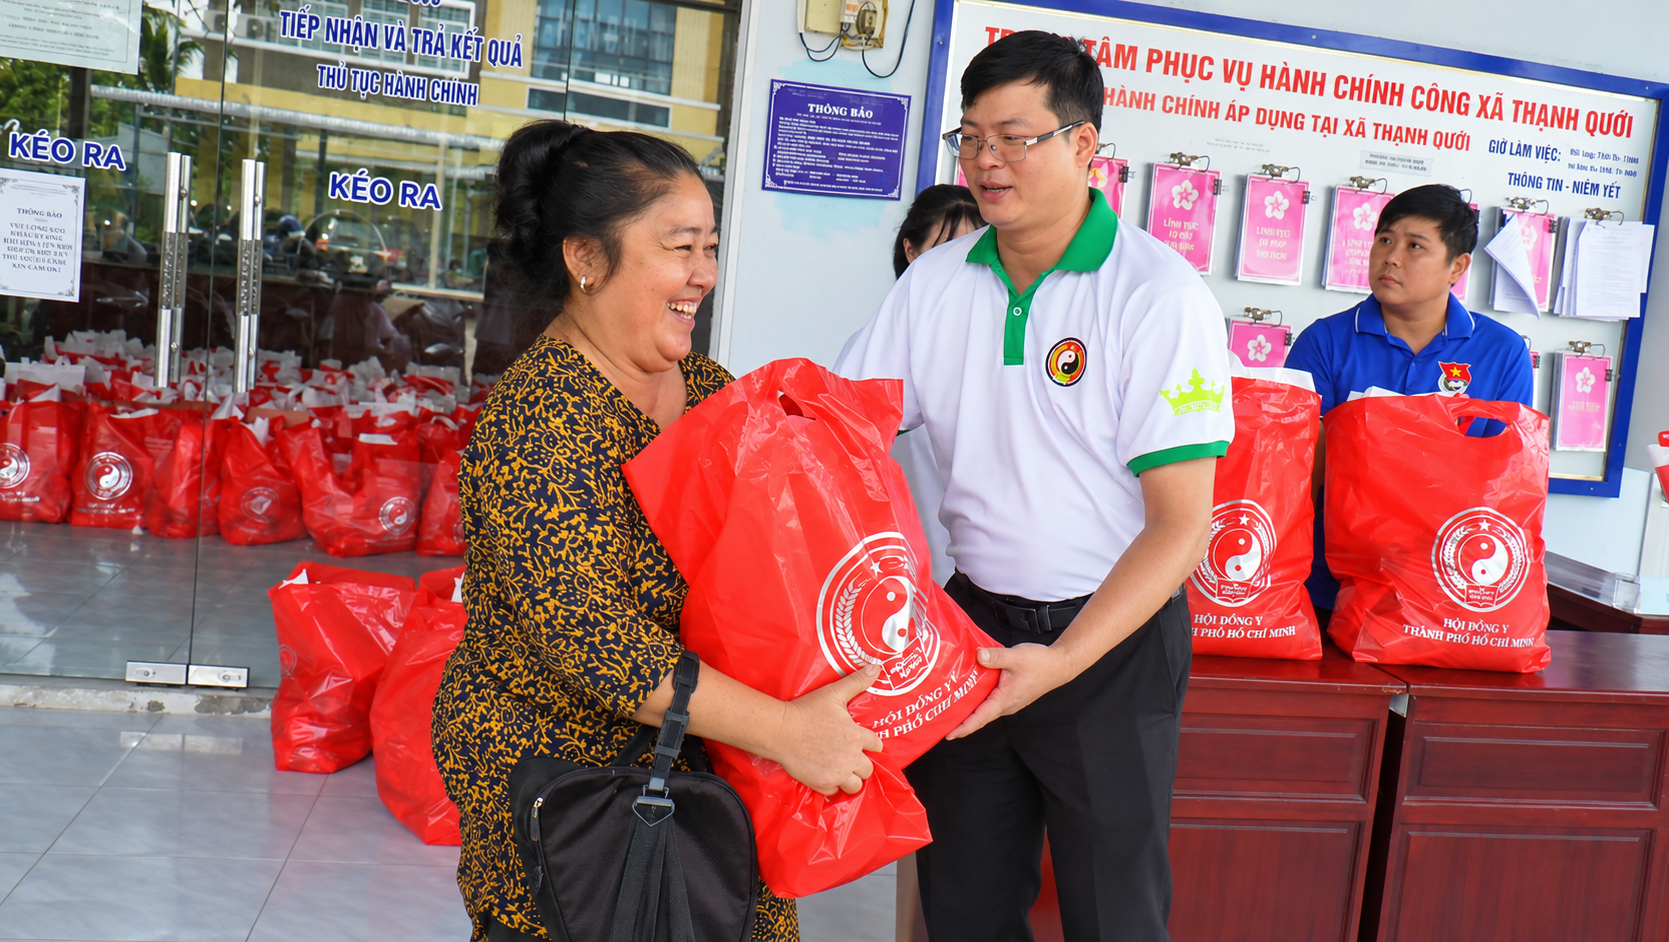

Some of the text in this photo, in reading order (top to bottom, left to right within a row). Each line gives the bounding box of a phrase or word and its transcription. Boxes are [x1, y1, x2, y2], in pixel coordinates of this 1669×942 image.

[280, 6, 523, 68] TIẾP NHẬN VÀ TRẢ KẾT QUẢ
[317, 61, 479, 106] THỦ TỤC HÀNH CHÍNH
[1083, 36, 1138, 71] TÂM
[1146, 48, 1214, 83] PHỤC
[1223, 58, 1253, 91] VỤ
[1260, 61, 1326, 96] HÀNH
[1334, 74, 1404, 107] CHÍNH
[1411, 82, 1470, 116] CÔNG
[1476, 92, 1504, 121] XÃ
[1512, 99, 1580, 132] THẠNH
[1103, 85, 1156, 111] HÀNH
[1162, 94, 1220, 120] CHÍNH
[1224, 99, 1250, 122] ÁP
[1255, 107, 1305, 131] DỤNG
[1312, 114, 1338, 138] TẠI
[1343, 117, 1366, 138] XÃ
[1373, 122, 1428, 146] THẠNH
[8, 129, 126, 171] KÉO RA
[1488, 138, 1508, 154] GIỜ
[1509, 140, 1532, 158] LÀM
[1535, 144, 1562, 164] VIỆC:
[328, 168, 443, 211] KÉO RA
[1508, 172, 1543, 190] THÔNG
[1546, 178, 1564, 192] TIN
[1603, 181, 1621, 199] YẾT
[1194, 612, 1217, 626] HỘI
[1255, 616, 1263, 626] Y
[1246, 627, 1268, 638] CHÍ
[1268, 626, 1296, 638] MINH
[1444, 618, 1466, 632] HỘI
[1502, 624, 1510, 634] Y
[1490, 637, 1510, 648] CHÍ
[872, 710, 902, 729] HỘI
